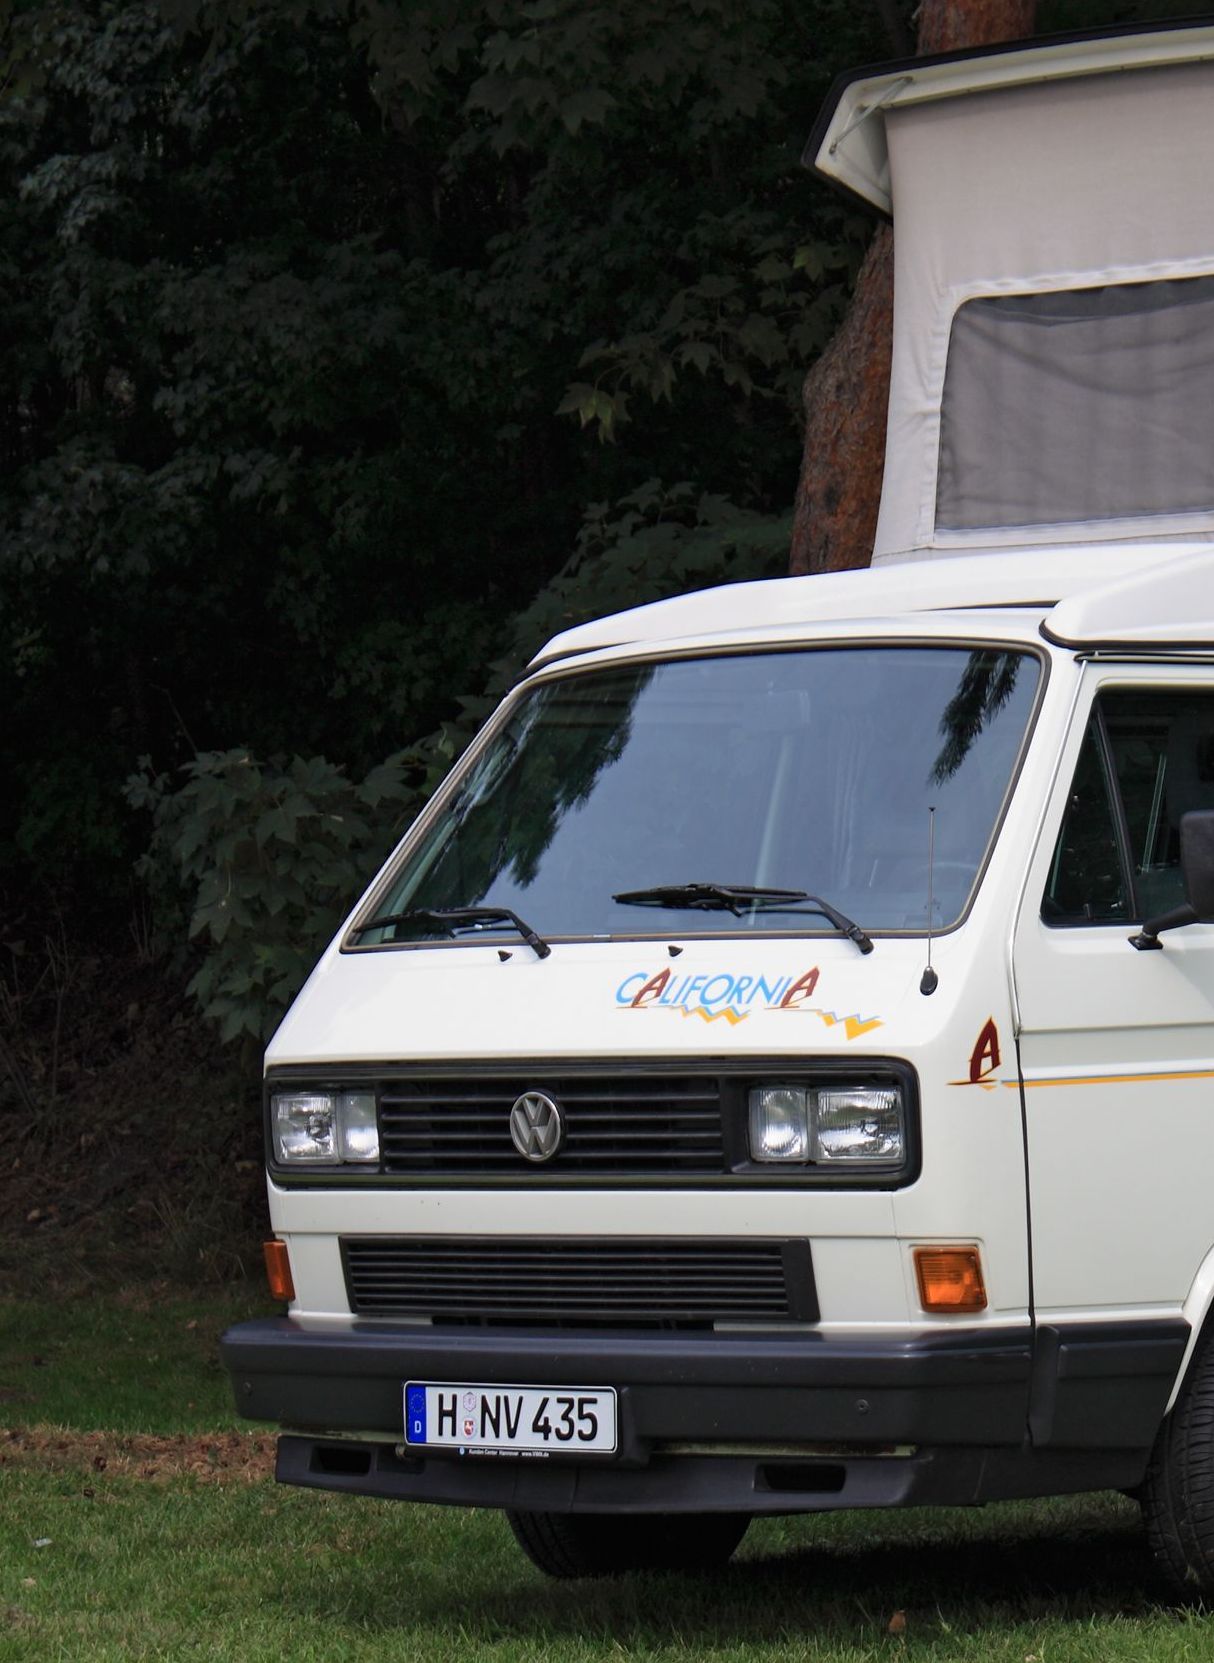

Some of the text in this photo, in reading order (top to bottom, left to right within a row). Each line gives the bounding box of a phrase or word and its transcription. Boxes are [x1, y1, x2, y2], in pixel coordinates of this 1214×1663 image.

[616, 966, 820, 1008] CALIFORNIA
[968, 1015, 1001, 1083] A
[510, 1092, 560, 1161] VW
[414, 1420, 422, 1434] D
[438, 1393, 598, 1441] H NV 435
